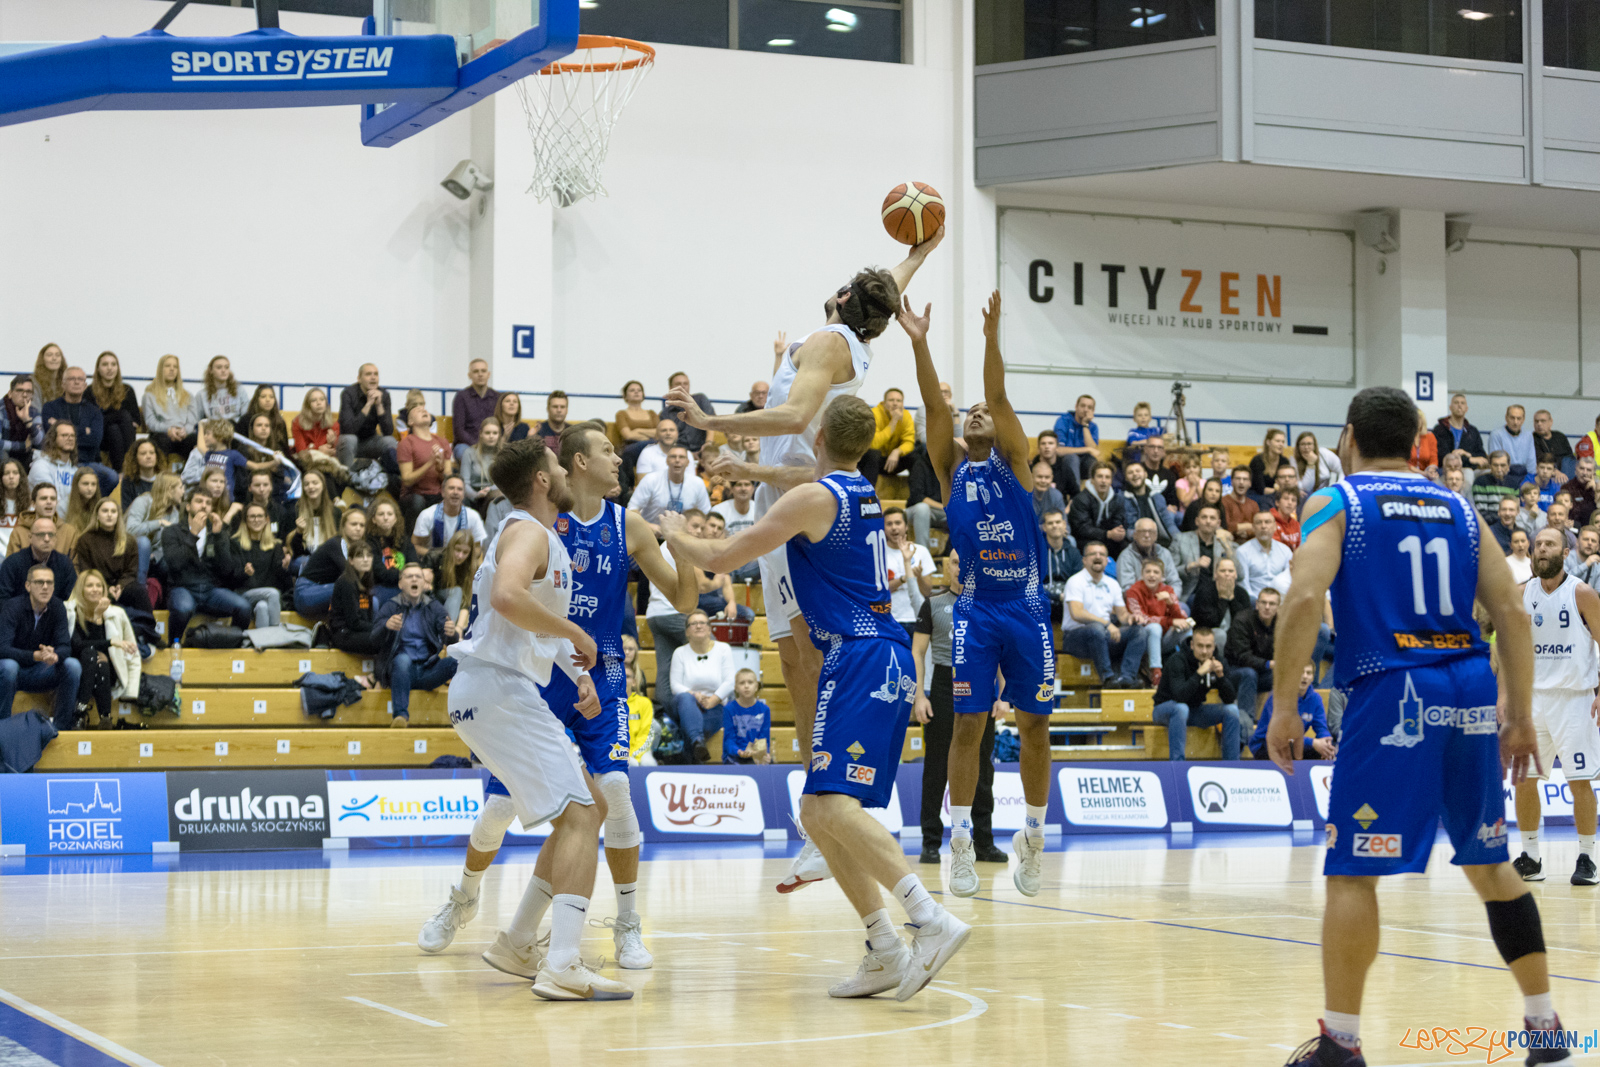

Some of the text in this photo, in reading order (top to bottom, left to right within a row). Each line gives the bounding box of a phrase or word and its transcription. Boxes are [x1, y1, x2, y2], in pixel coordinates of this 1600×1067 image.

[171, 47, 393, 79] SPORT SYSTEM
[1028, 258, 1282, 318] CITYZEN
[1182, 318, 1213, 329] KLUB
[1218, 319, 1282, 332] SPORTOWY
[517, 329, 530, 352] C
[1418, 375, 1431, 397] B
[595, 554, 612, 575] 14
[865, 529, 889, 591] 10
[1397, 535, 1454, 616] 11
[1558, 609, 1570, 628] 9
[1393, 632, 1471, 649] WA-BET
[1574, 752, 1586, 770] 9
[849, 765, 873, 781] zec
[1078, 777, 1143, 793] HELMEX
[174, 787, 324, 821] drukma
[377, 795, 479, 813] funclub
[692, 796, 745, 811] Danuty
[1080, 797, 1146, 808] EXHIBITIONS
[1111, 813, 1149, 821] REKLAMOWA
[49, 820, 122, 840] HOTEL
[178, 819, 325, 835] DRUKARNIA SKOCZYŃSKI
[49, 840, 123, 851] POZNAŃSKI
[1356, 835, 1398, 853] zec
